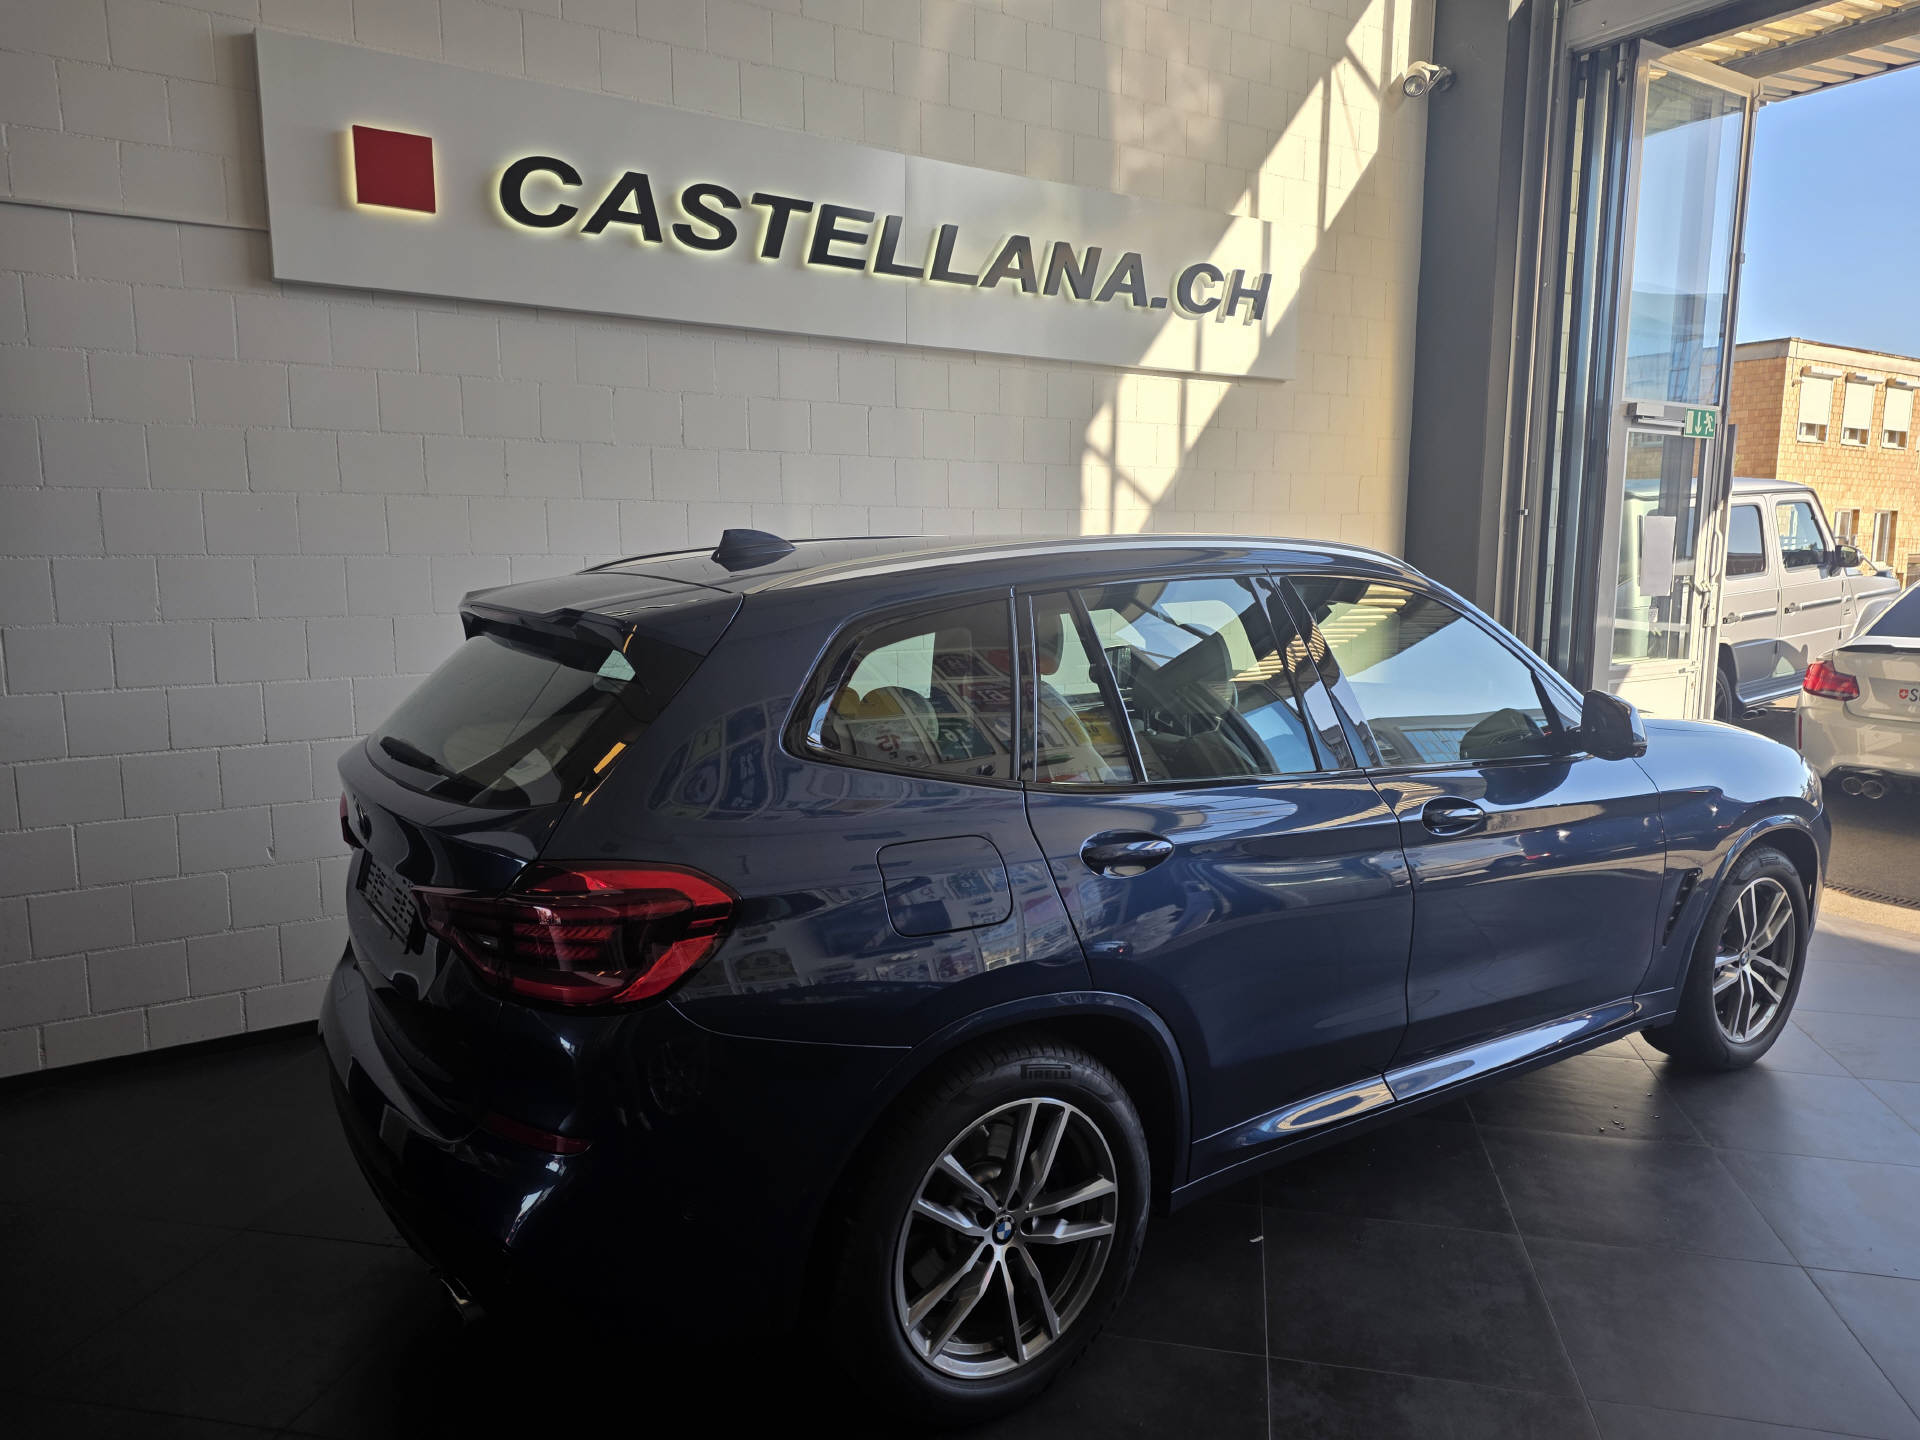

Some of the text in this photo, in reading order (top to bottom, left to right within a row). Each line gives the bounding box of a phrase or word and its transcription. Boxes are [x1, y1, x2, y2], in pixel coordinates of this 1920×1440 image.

[499, 155, 1271, 322] CASTELLANA.CH
[1909, 688, 1920, 702] S
[1020, 1063, 1072, 1080] PIRELLI
